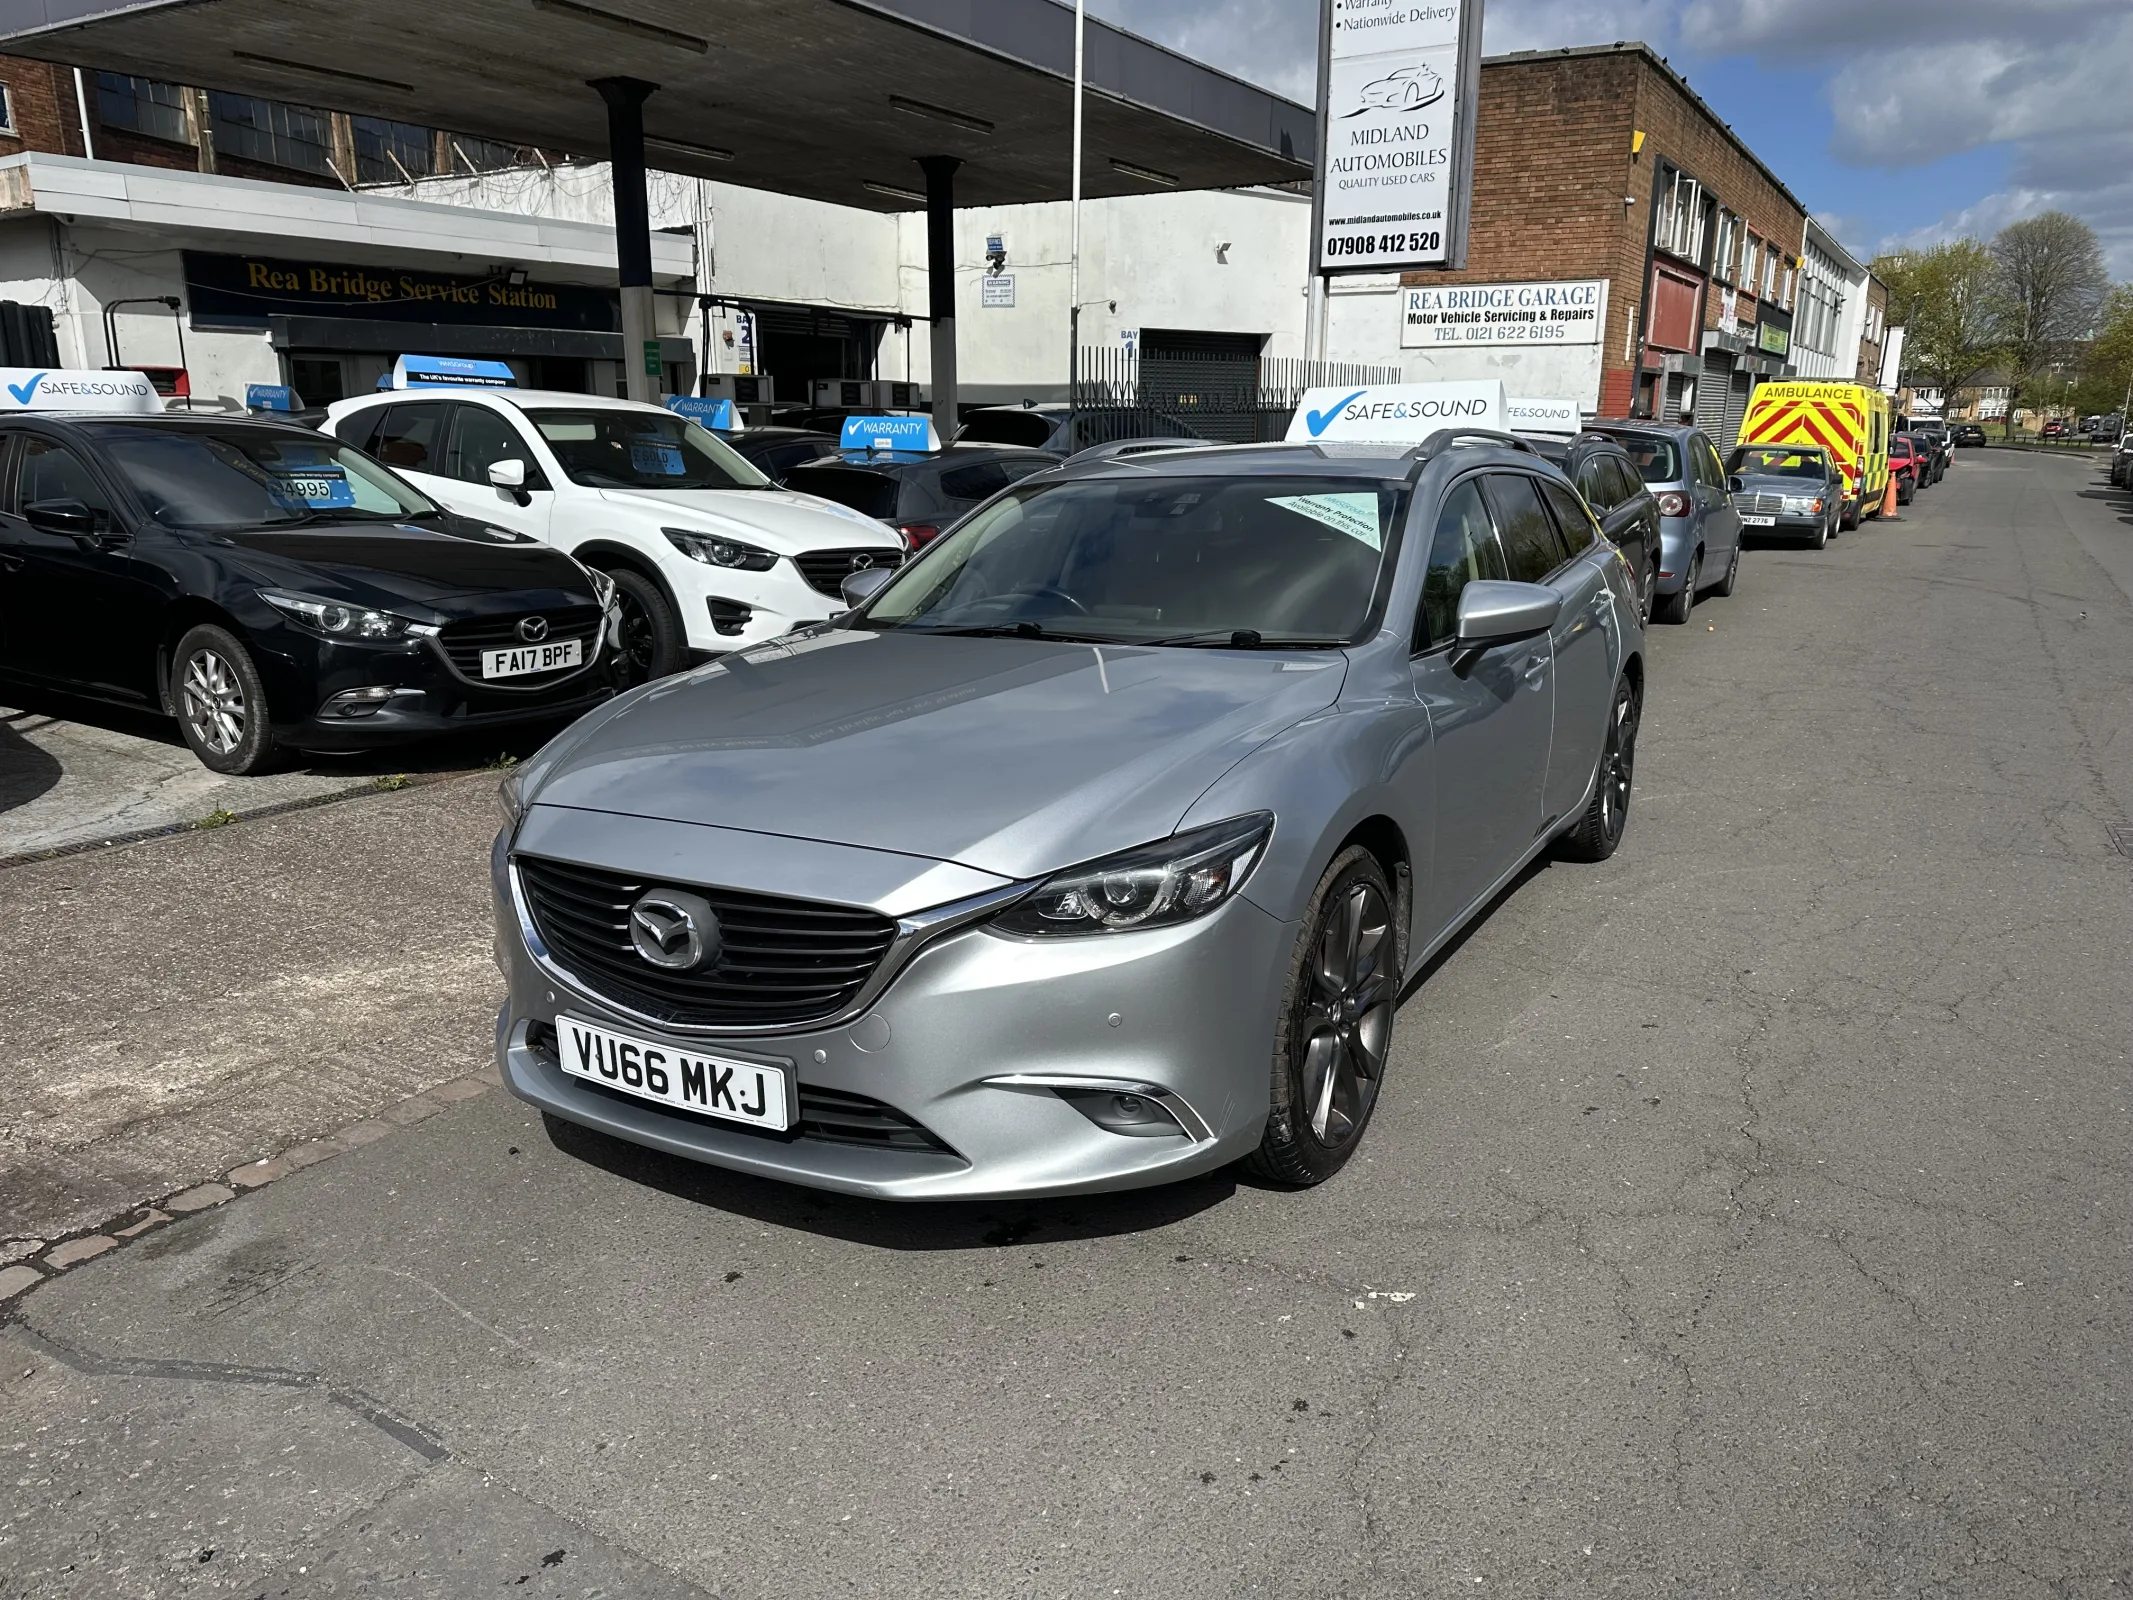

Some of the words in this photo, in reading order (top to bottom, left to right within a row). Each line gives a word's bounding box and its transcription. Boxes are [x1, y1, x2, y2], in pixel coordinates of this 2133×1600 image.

[1344, 11, 1406, 31] Nationwide
[1409, 6, 1457, 22] Delivery
[1351, 123, 1429, 146] MIDLAND
[1330, 148, 1447, 173] AUTOMOBILES
[1338, 177, 1379, 190] QUALITY
[1381, 174, 1407, 186] USED
[1409, 172, 1435, 184] CARS
[1328, 210, 1441, 226] www.midlandautomobiles.co.uk
[1327, 236, 1375, 256] 07908
[1379, 233, 1406, 253] 412
[1409, 231, 1440, 251] 520
[247, 263, 300, 290] Rea
[309, 268, 392, 301] Bridge
[400, 276, 479, 304] Service
[489, 283, 557, 309] Station
[1409, 292, 1445, 310] REA
[1447, 289, 1514, 309] BRIDGE
[1518, 286, 1596, 307] GARAGE
[1407, 312, 1438, 325] Motor
[1440, 310, 1481, 324] Vehicle
[1484, 309, 1536, 323] Servicing
[1539, 310, 1547, 321] &
[1550, 308, 1595, 322] Repairs
[741, 326, 751, 344] 2
[1121, 331, 1138, 339] BAY
[1434, 327, 1463, 341] TEL.
[1466, 326, 1493, 340] 0121
[1497, 325, 1526, 339] 622
[1529, 324, 1565, 339] 6195
[1125, 341, 1133, 358] 1
[40, 382, 148, 396] SAFE&SOUND
[257, 388, 287, 399] WARRANTY
[1764, 387, 1853, 399] AMBULANCE
[681, 401, 725, 415] WARRANTY
[1344, 399, 1487, 421] SAFE&SOUND
[1507, 407, 1570, 419] FE&SOUND
[863, 422, 923, 435] WARRANTY
[642, 449, 669, 464] SOLD
[1288, 502, 1324, 518] Available
[1324, 514, 1336, 523] on
[1335, 518, 1351, 530] this
[1351, 526, 1367, 537] car
[1299, 497, 1333, 513] Warranty
[1333, 510, 1374, 532] Protection
[495, 649, 537, 673] FA17
[542, 644, 573, 667] BPF
[572, 1027, 669, 1096] VU66
[680, 1057, 766, 1117] MKJ
